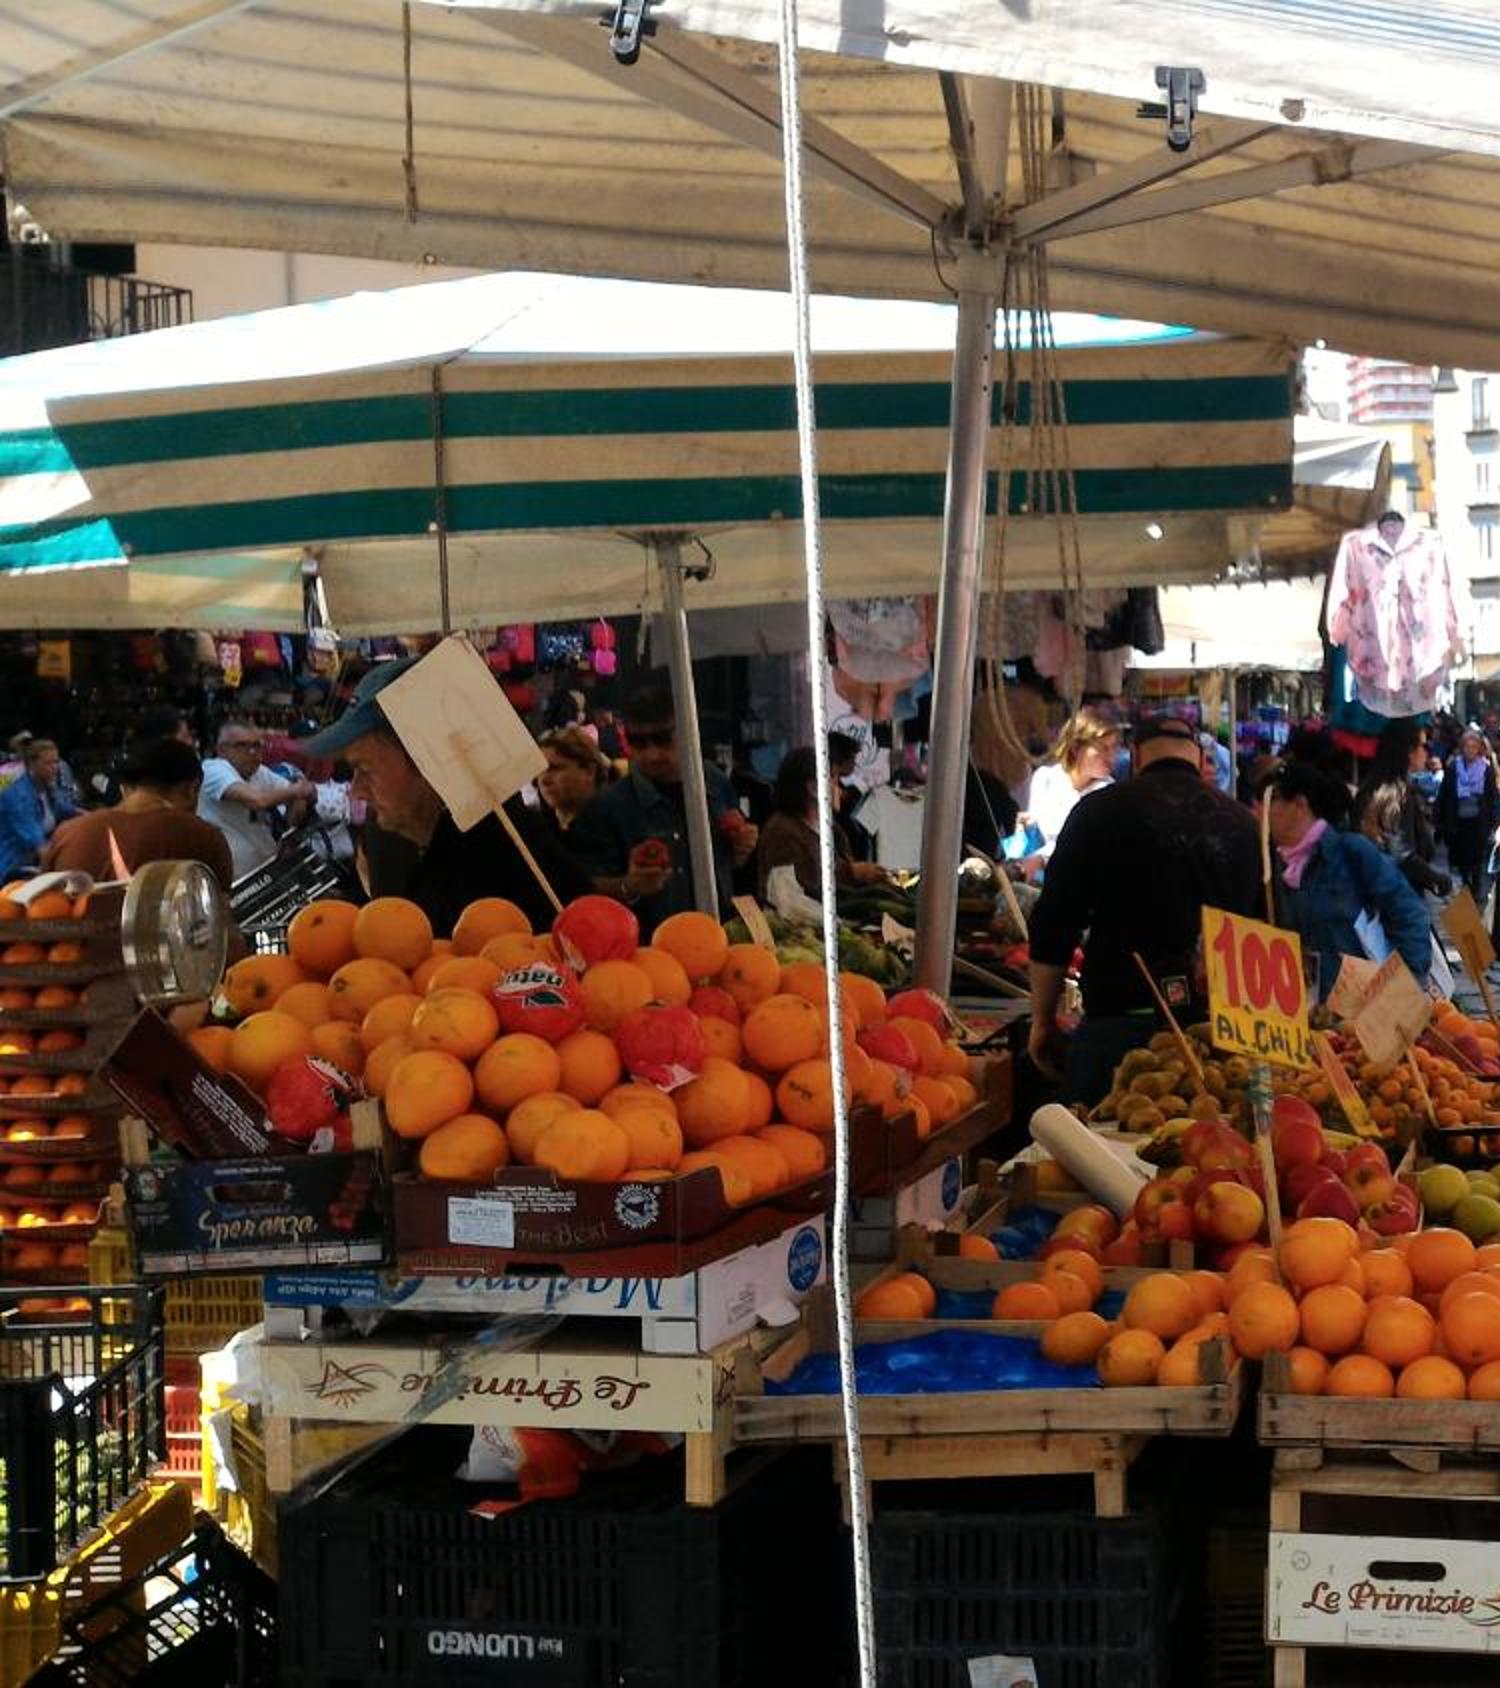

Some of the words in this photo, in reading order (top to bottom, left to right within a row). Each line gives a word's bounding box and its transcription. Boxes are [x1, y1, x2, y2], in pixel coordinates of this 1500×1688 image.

[400, 1373, 583, 1412] Primiie
[594, 1375, 651, 1411] Le
[1302, 1581, 1341, 1615] Le
[1347, 1579, 1476, 1615] Primizie
[427, 1631, 536, 1660] LUONGO
